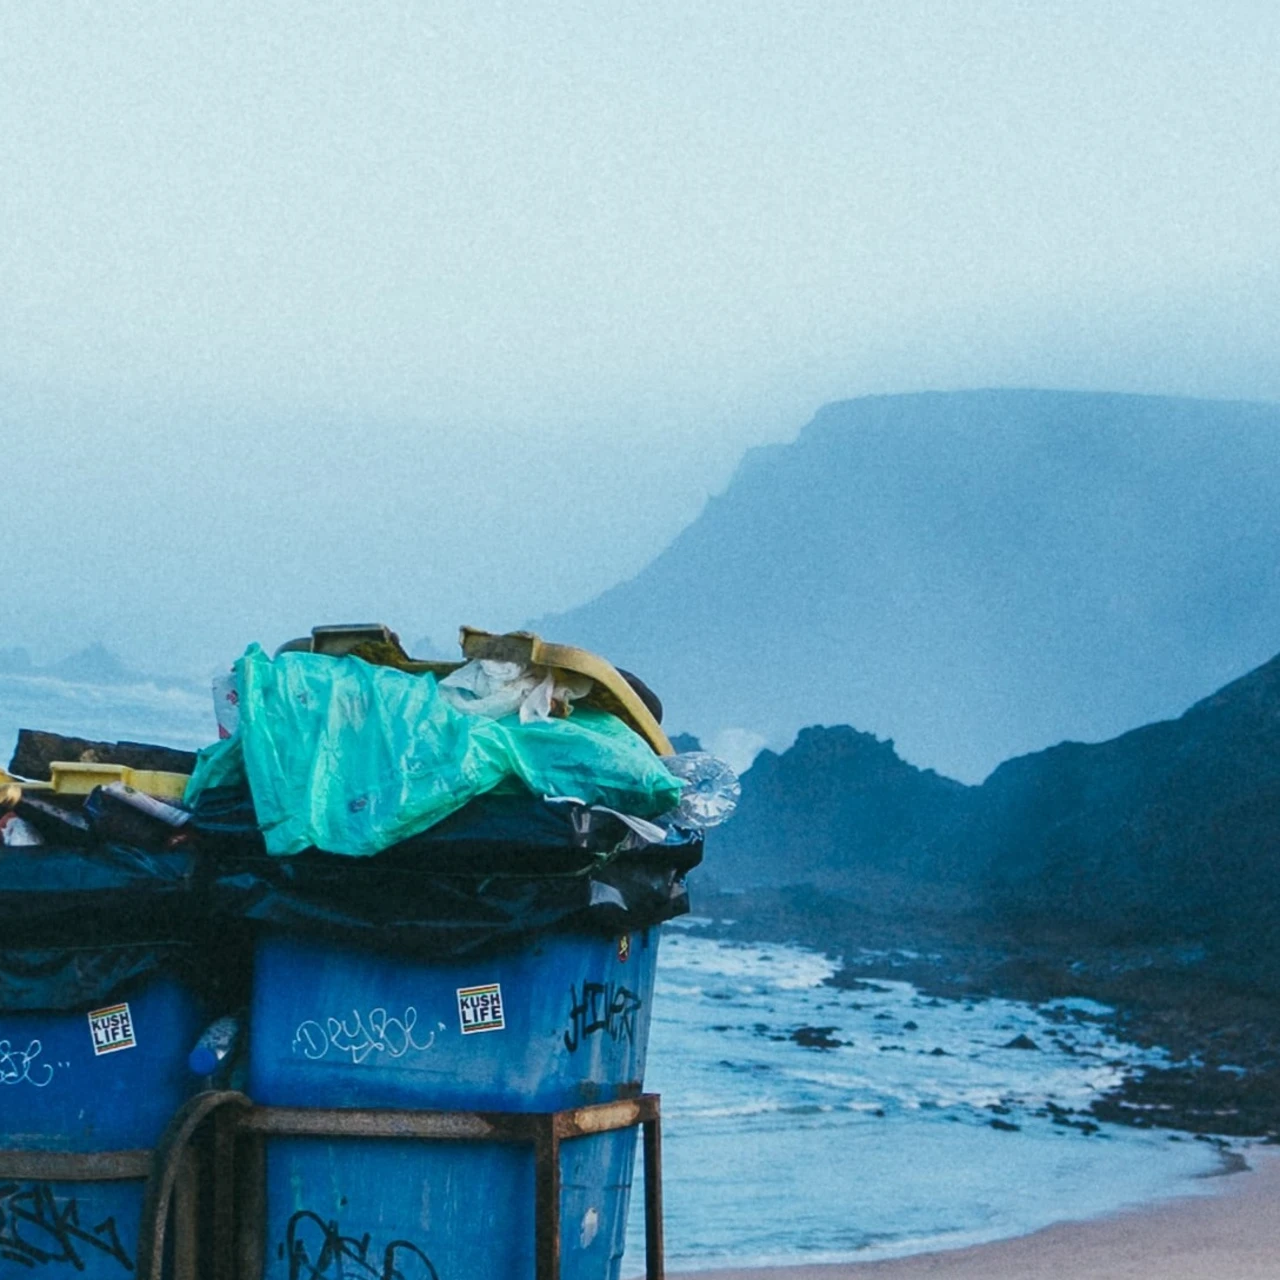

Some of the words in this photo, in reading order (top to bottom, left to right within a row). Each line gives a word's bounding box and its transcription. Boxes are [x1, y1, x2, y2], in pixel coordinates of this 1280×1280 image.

[460, 993, 500, 1010] KUSH
[91, 1012, 129, 1031] KUSH
[461, 1006, 502, 1024] LIFE
[94, 1024, 132, 1045] LIFE
